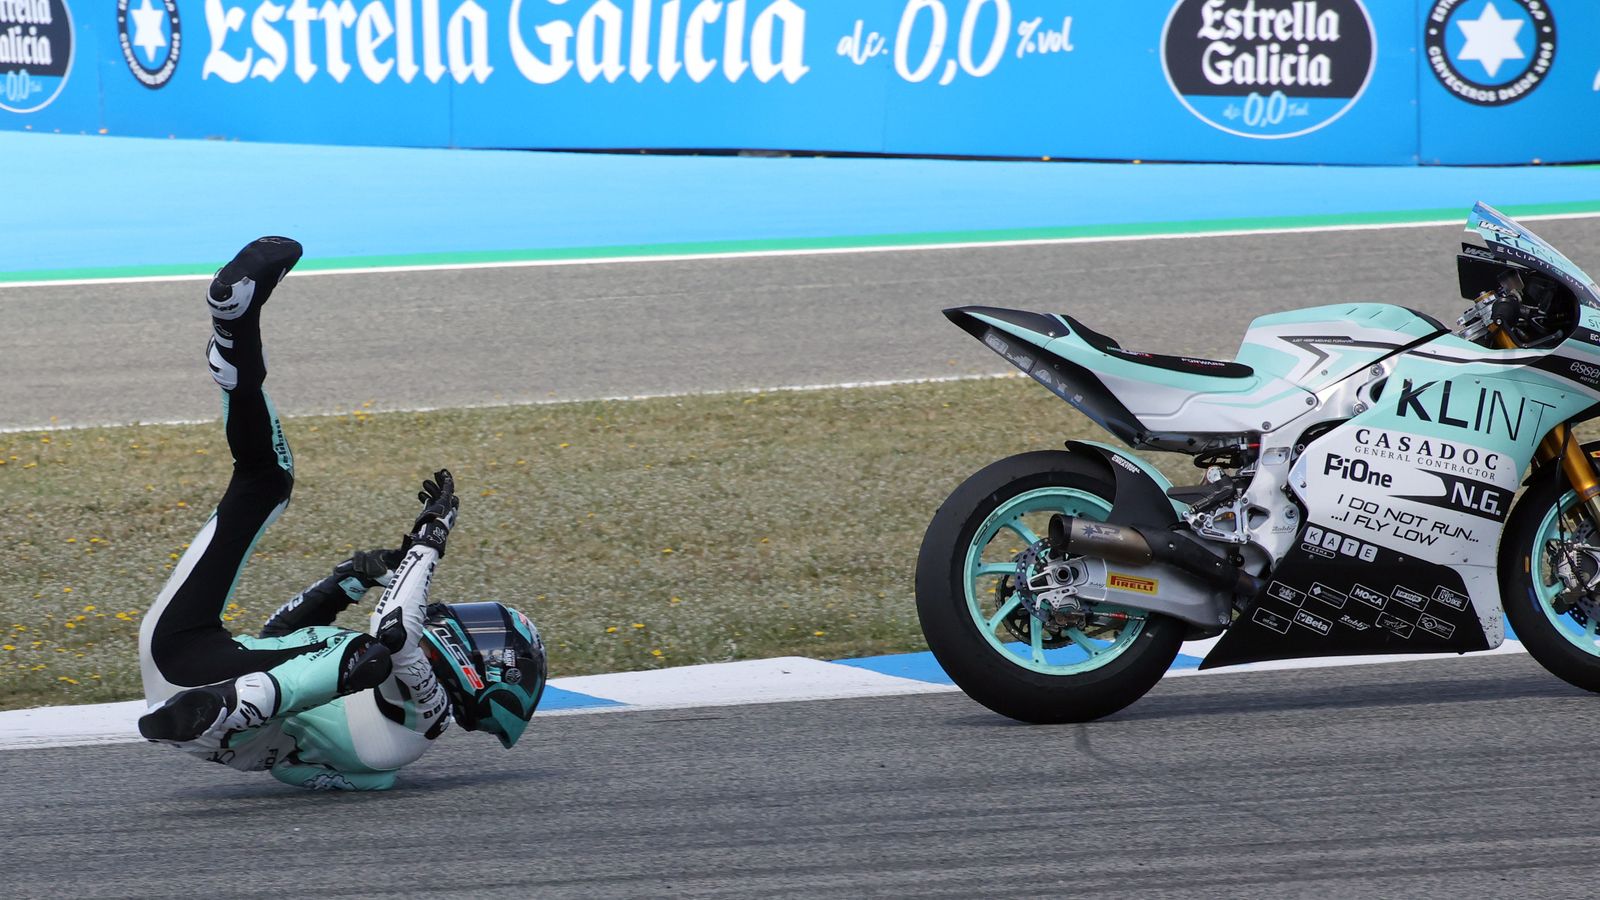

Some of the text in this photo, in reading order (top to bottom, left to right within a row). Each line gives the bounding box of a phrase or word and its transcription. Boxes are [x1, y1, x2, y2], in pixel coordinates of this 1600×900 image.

[1197, 0, 1340, 42] Estrella
[202, 0, 494, 84] Estrella
[508, 0, 810, 84] Galicia
[894, 0, 1011, 85] 0,0
[1202, 41, 1332, 86] Galicia
[1243, 90, 1287, 127] 0,0
[1396, 378, 1557, 447] KLINT
[1354, 445, 1496, 481] GENERAL CONTRACTOR
[1355, 429, 1499, 470] CASADOC
[1324, 453, 1393, 488] PiOne
[1451, 482, 1501, 516] N.G.
[1349, 497, 1379, 515] DO
[1383, 506, 1428, 528] NOT
[1431, 521, 1480, 543] RUN...
[1353, 514, 1391, 532] FLY
[1392, 527, 1440, 547] LOW
[1307, 529, 1375, 560] KATE
[1110, 575, 1155, 592] PIRELLI
[1306, 614, 1329, 632] Beta
[432, 627, 485, 690] LS2
